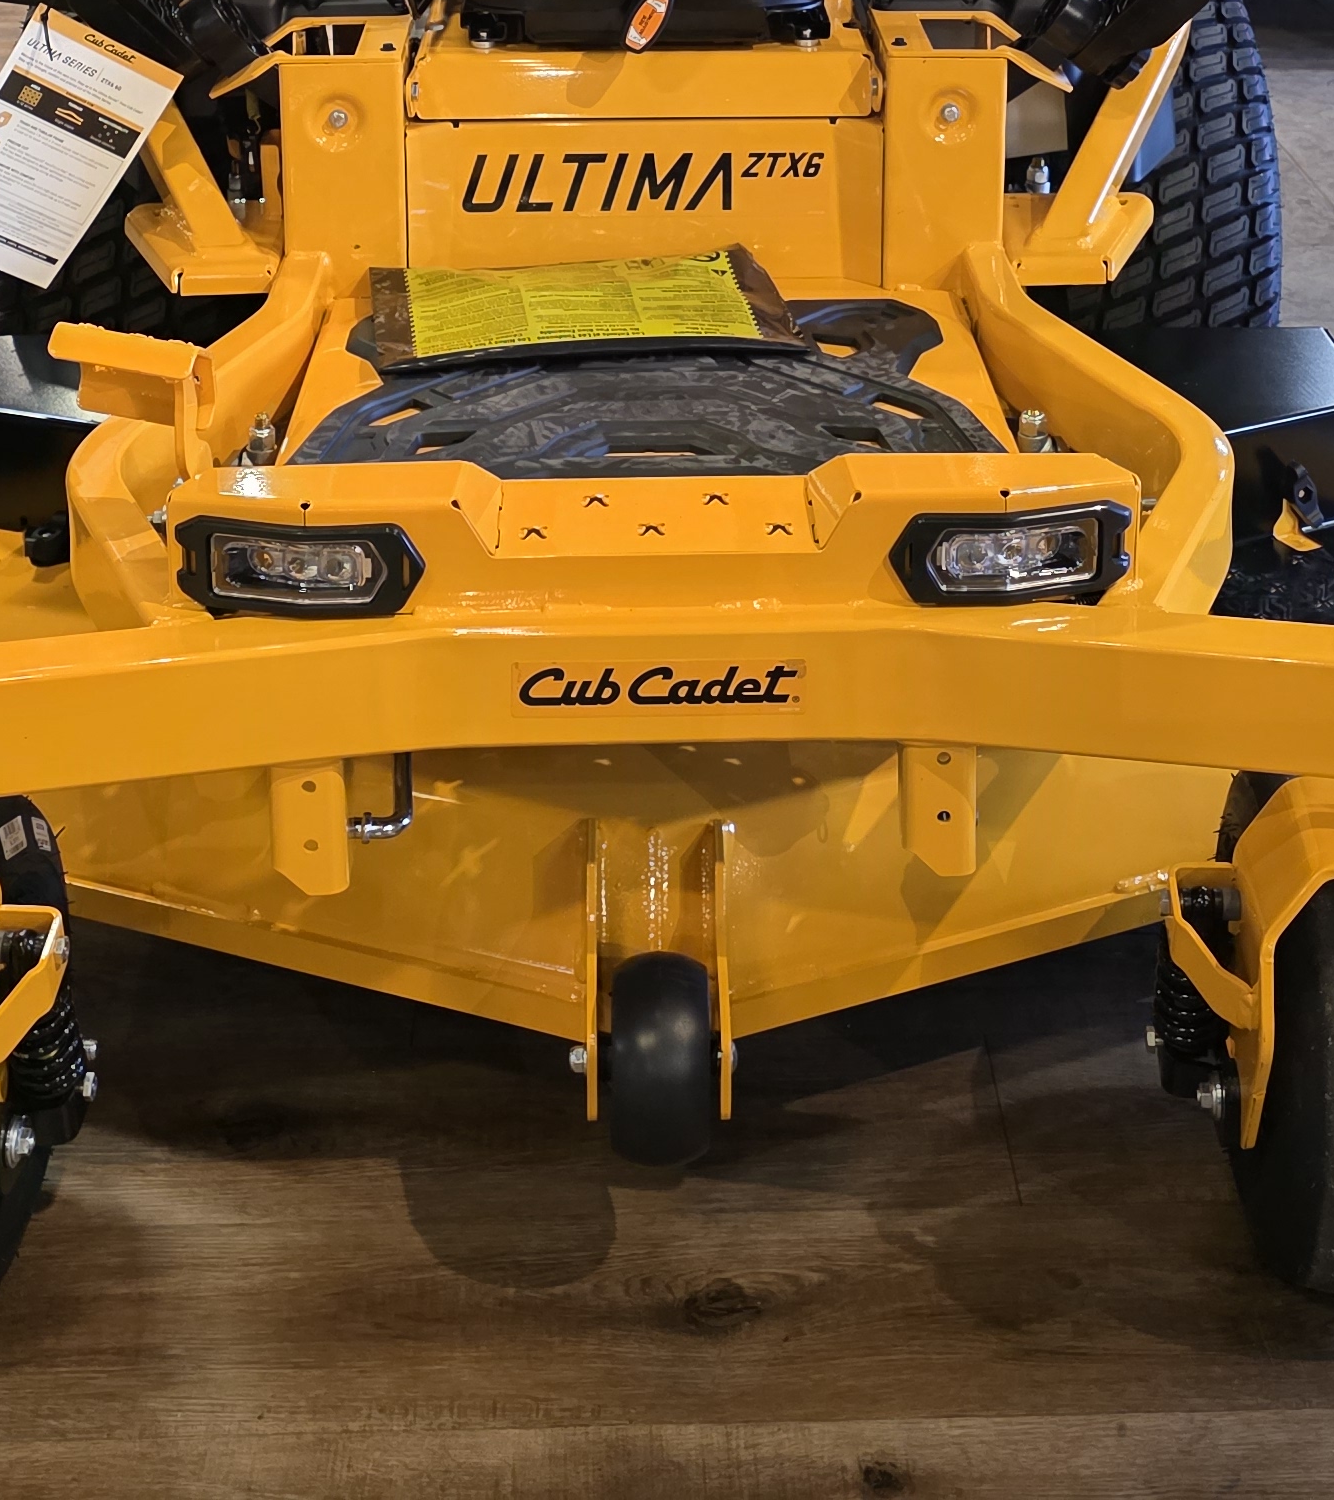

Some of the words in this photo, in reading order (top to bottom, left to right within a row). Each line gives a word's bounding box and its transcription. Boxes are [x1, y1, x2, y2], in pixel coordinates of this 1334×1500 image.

[62, 55, 98, 78] SERIES
[84, 33, 105, 48] Cub
[103, 43, 137, 65] Cadet
[461, 152, 733, 213] ULTIMA
[740, 152, 825, 178] ZTX6
[519, 667, 621, 707] Cub
[627, 665, 799, 706] Cadet
